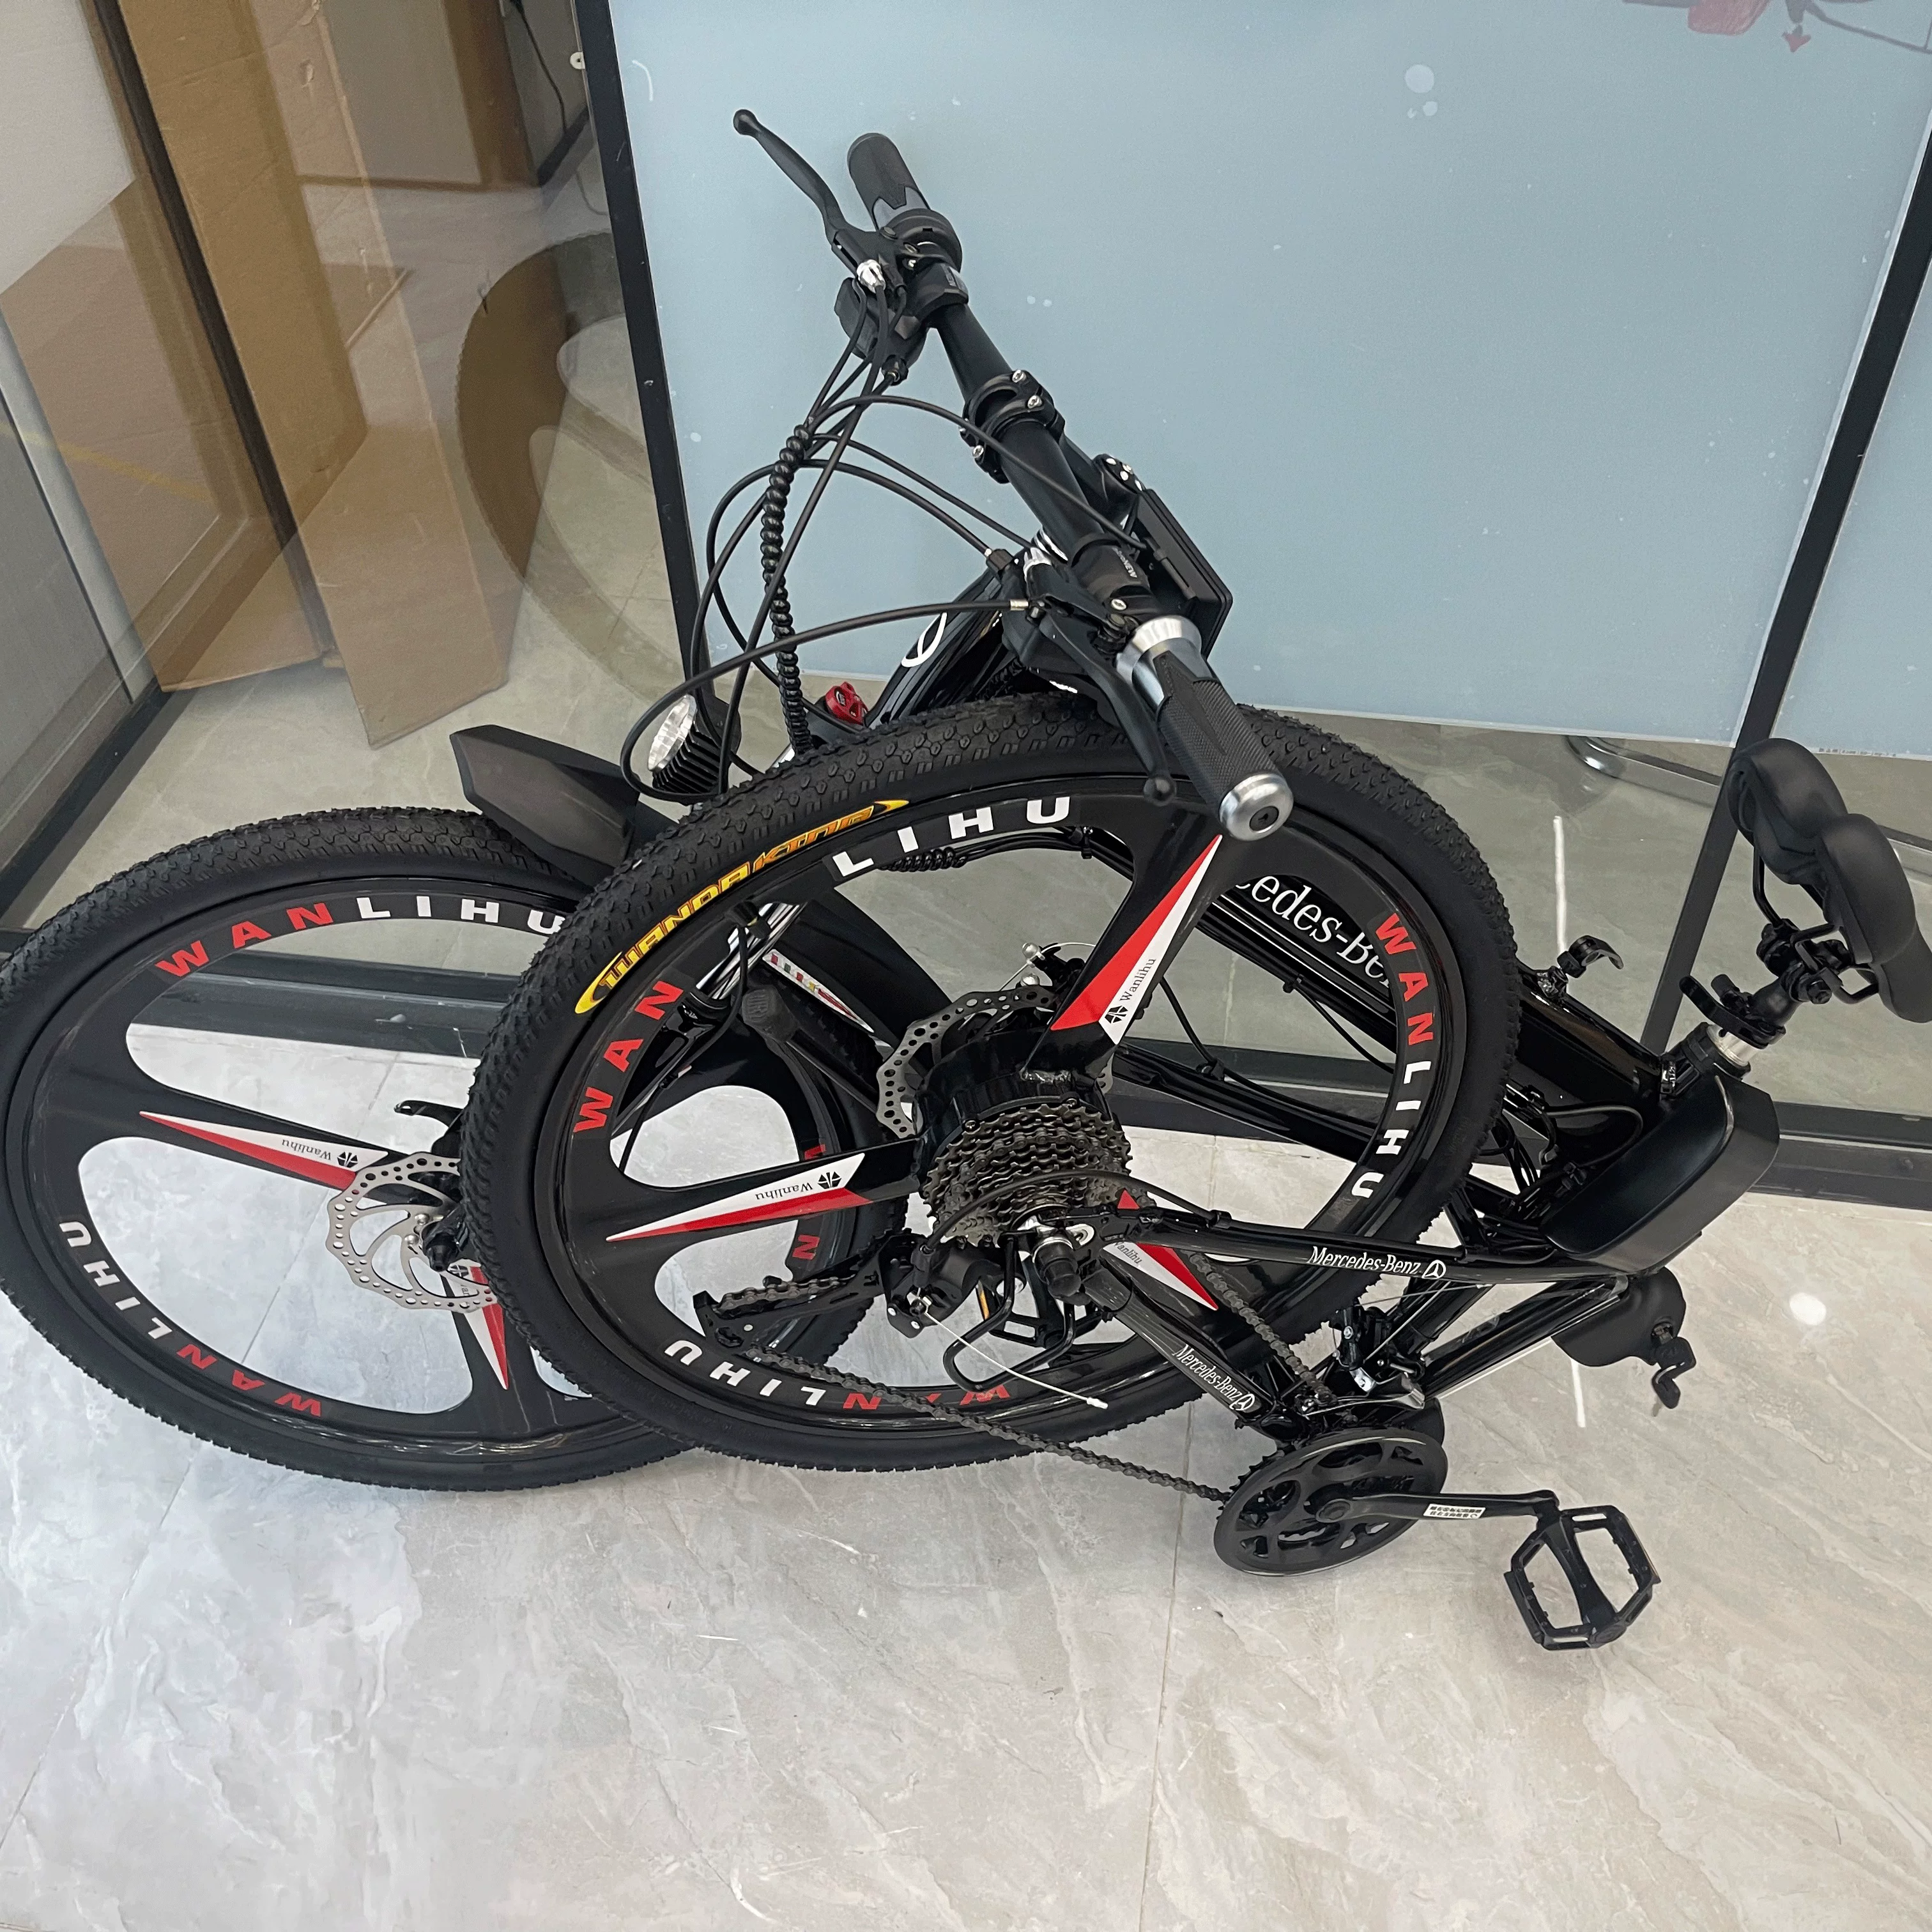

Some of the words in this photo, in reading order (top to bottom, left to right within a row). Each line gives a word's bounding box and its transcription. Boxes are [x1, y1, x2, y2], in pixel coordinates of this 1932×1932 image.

[1236, 875, 1390, 988] edes-Be
[1119, 959, 1156, 1001] Wanlihu
[282, 1139, 331, 1160] Wanlihu
[755, 1182, 813, 1200] Wanlihu
[1307, 1246, 1422, 1275] Mercedes-Benz
[1172, 1344, 1243, 1401] Mercedes-Benz
